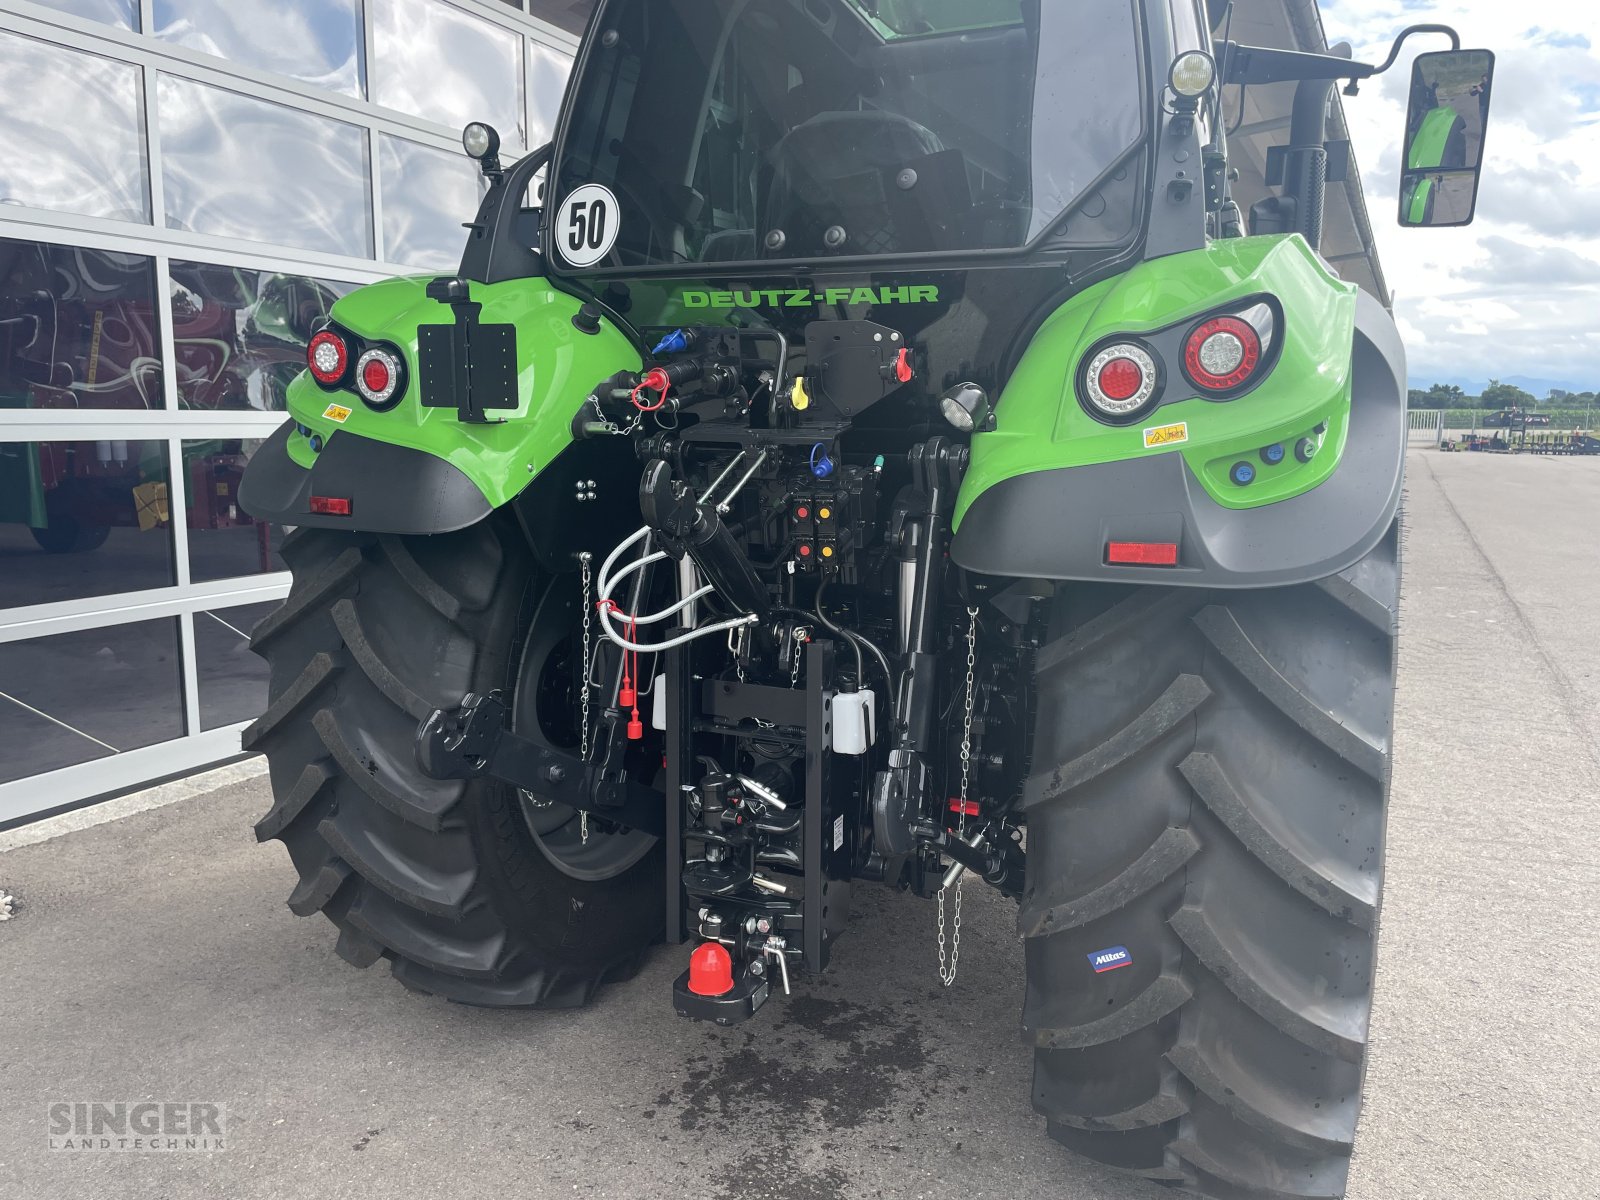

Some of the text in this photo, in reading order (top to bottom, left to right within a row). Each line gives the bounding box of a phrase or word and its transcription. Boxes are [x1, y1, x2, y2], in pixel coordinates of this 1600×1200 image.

[568, 199, 607, 252] 50
[682, 285, 939, 308] DEUTZ-FAHR
[1095, 951, 1126, 966] Mitas
